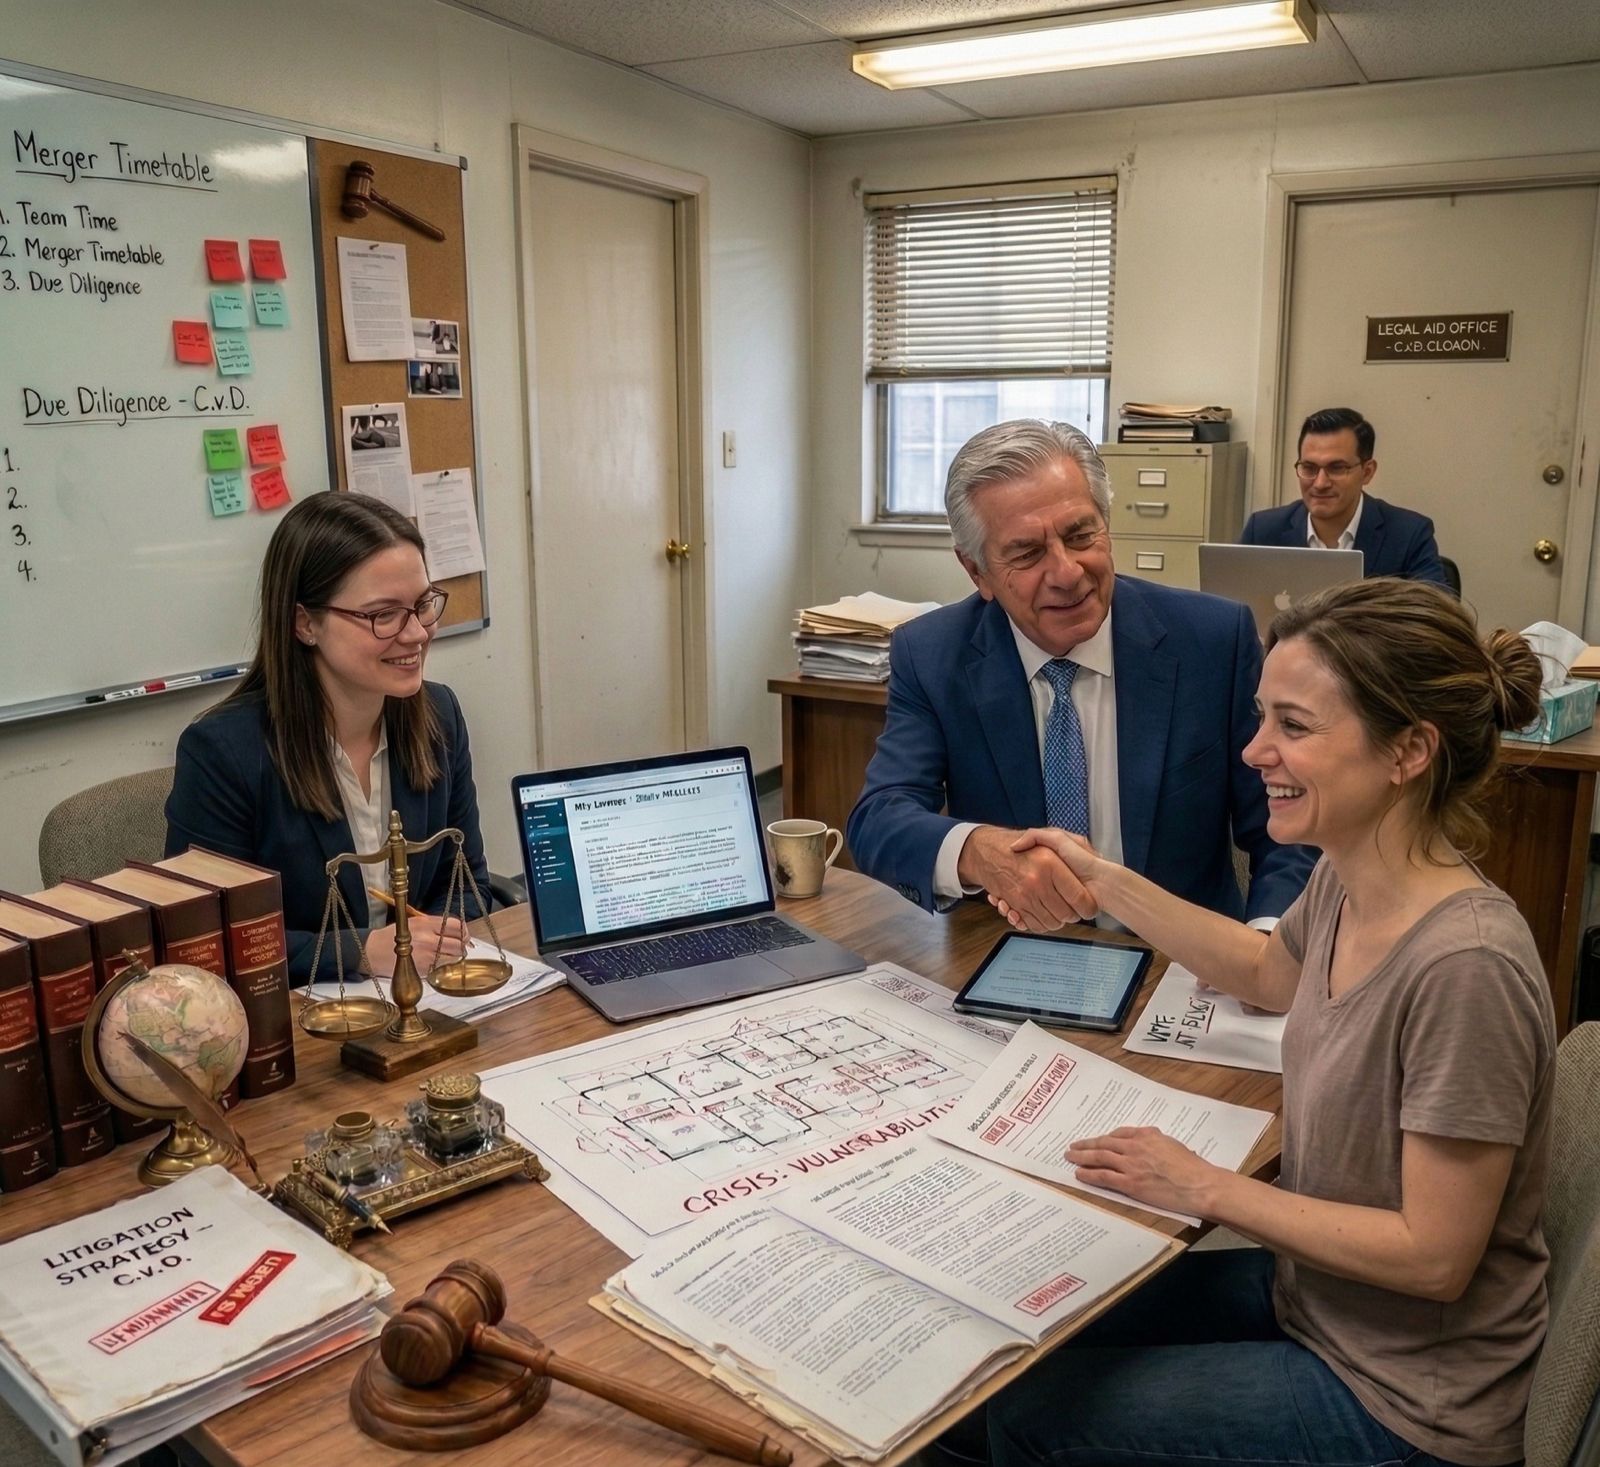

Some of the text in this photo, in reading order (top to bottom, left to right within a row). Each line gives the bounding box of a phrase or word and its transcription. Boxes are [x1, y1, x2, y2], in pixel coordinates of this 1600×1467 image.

[14, 130, 214, 183] Merger Timetable
[16, 201, 67, 227] Team
[73, 205, 118, 231] Time
[0, 235, 165, 267] 2. Merger Timetable
[2, 269, 142, 302] 3. Due Diligence
[1378, 320, 1498, 336] LEGAL AID OFFICE
[23, 387, 70, 418] Due
[77, 386, 171, 427] Diligence
[4, 447, 20, 472] 1.
[7, 486, 28, 510] 2.
[12, 524, 31, 546] 3.
[17, 559, 37, 582] 4.
[683, 1168, 789, 1214] CRISIS:
[43, 1207, 194, 1269] LITIGATION
[56, 1228, 190, 1286] STRATEGY
